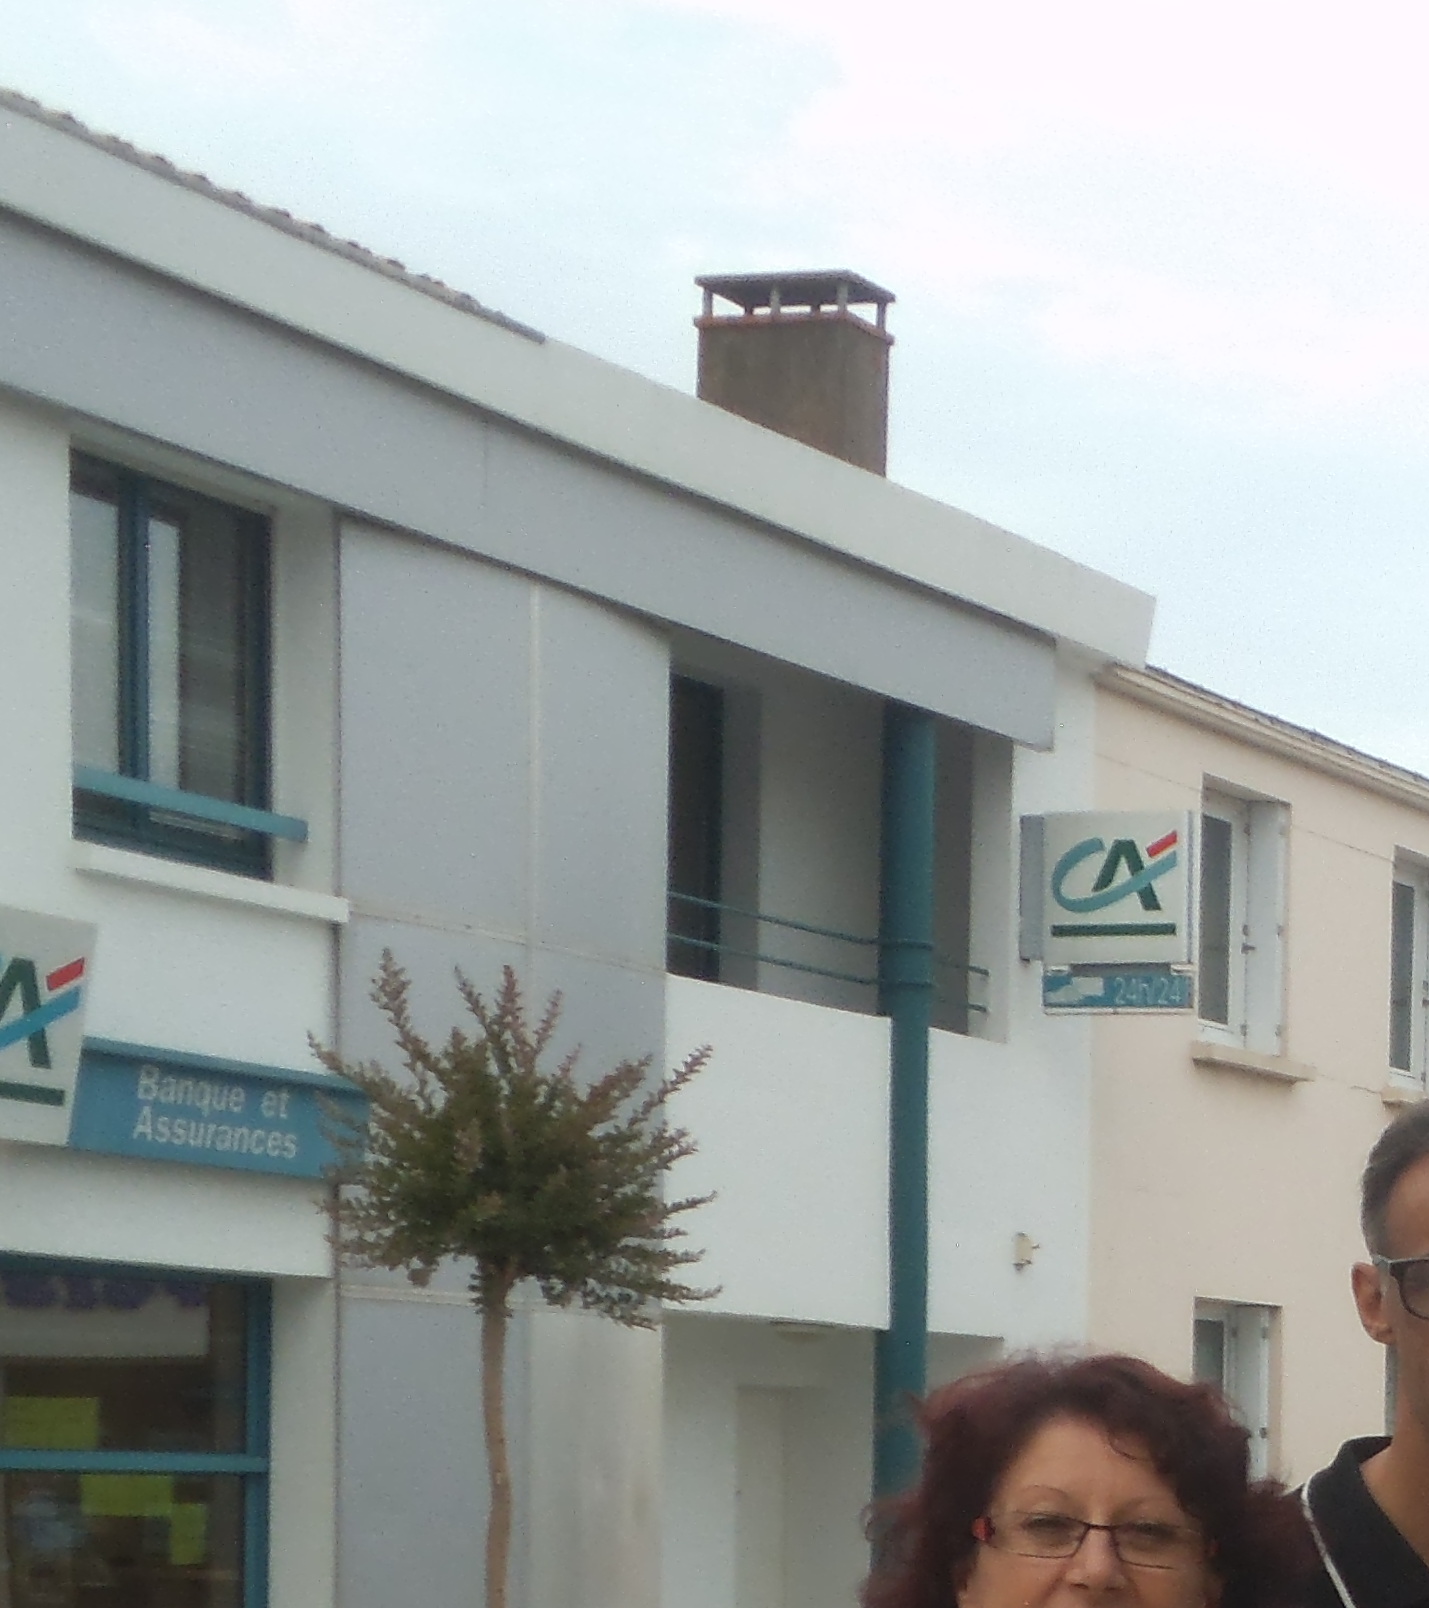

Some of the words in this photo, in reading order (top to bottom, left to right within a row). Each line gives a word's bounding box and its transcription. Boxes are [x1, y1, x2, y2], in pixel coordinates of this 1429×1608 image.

[137, 1064, 246, 1117] Banque
[261, 1089, 290, 1119] et
[132, 1105, 297, 1159] Assurances
